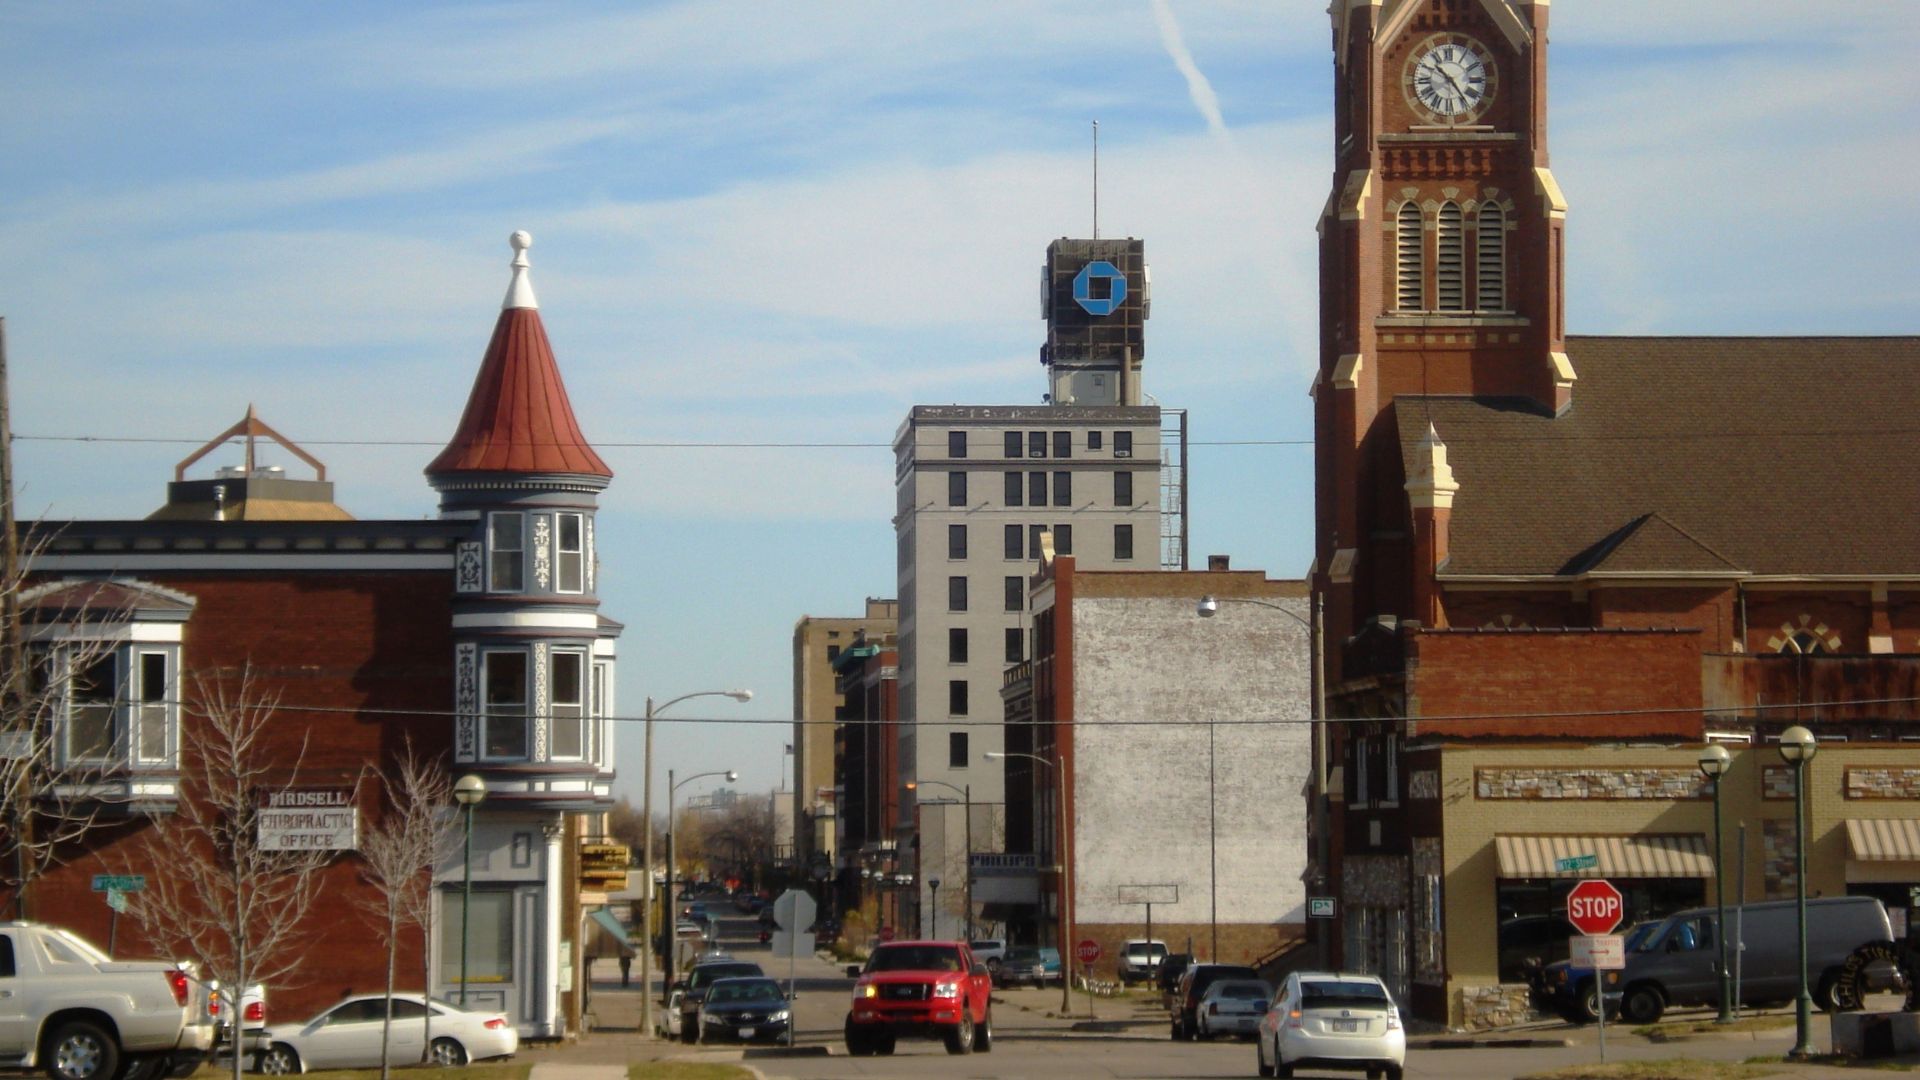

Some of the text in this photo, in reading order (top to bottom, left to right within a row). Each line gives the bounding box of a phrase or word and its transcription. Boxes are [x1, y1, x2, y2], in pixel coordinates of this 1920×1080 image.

[269, 791, 346, 806] BIRDSELL
[260, 813, 353, 830] CHIROPRACTIC
[279, 834, 335, 847] OFFICE
[1572, 896, 1618, 918] STOP
[1077, 945, 1098, 958] STOP
